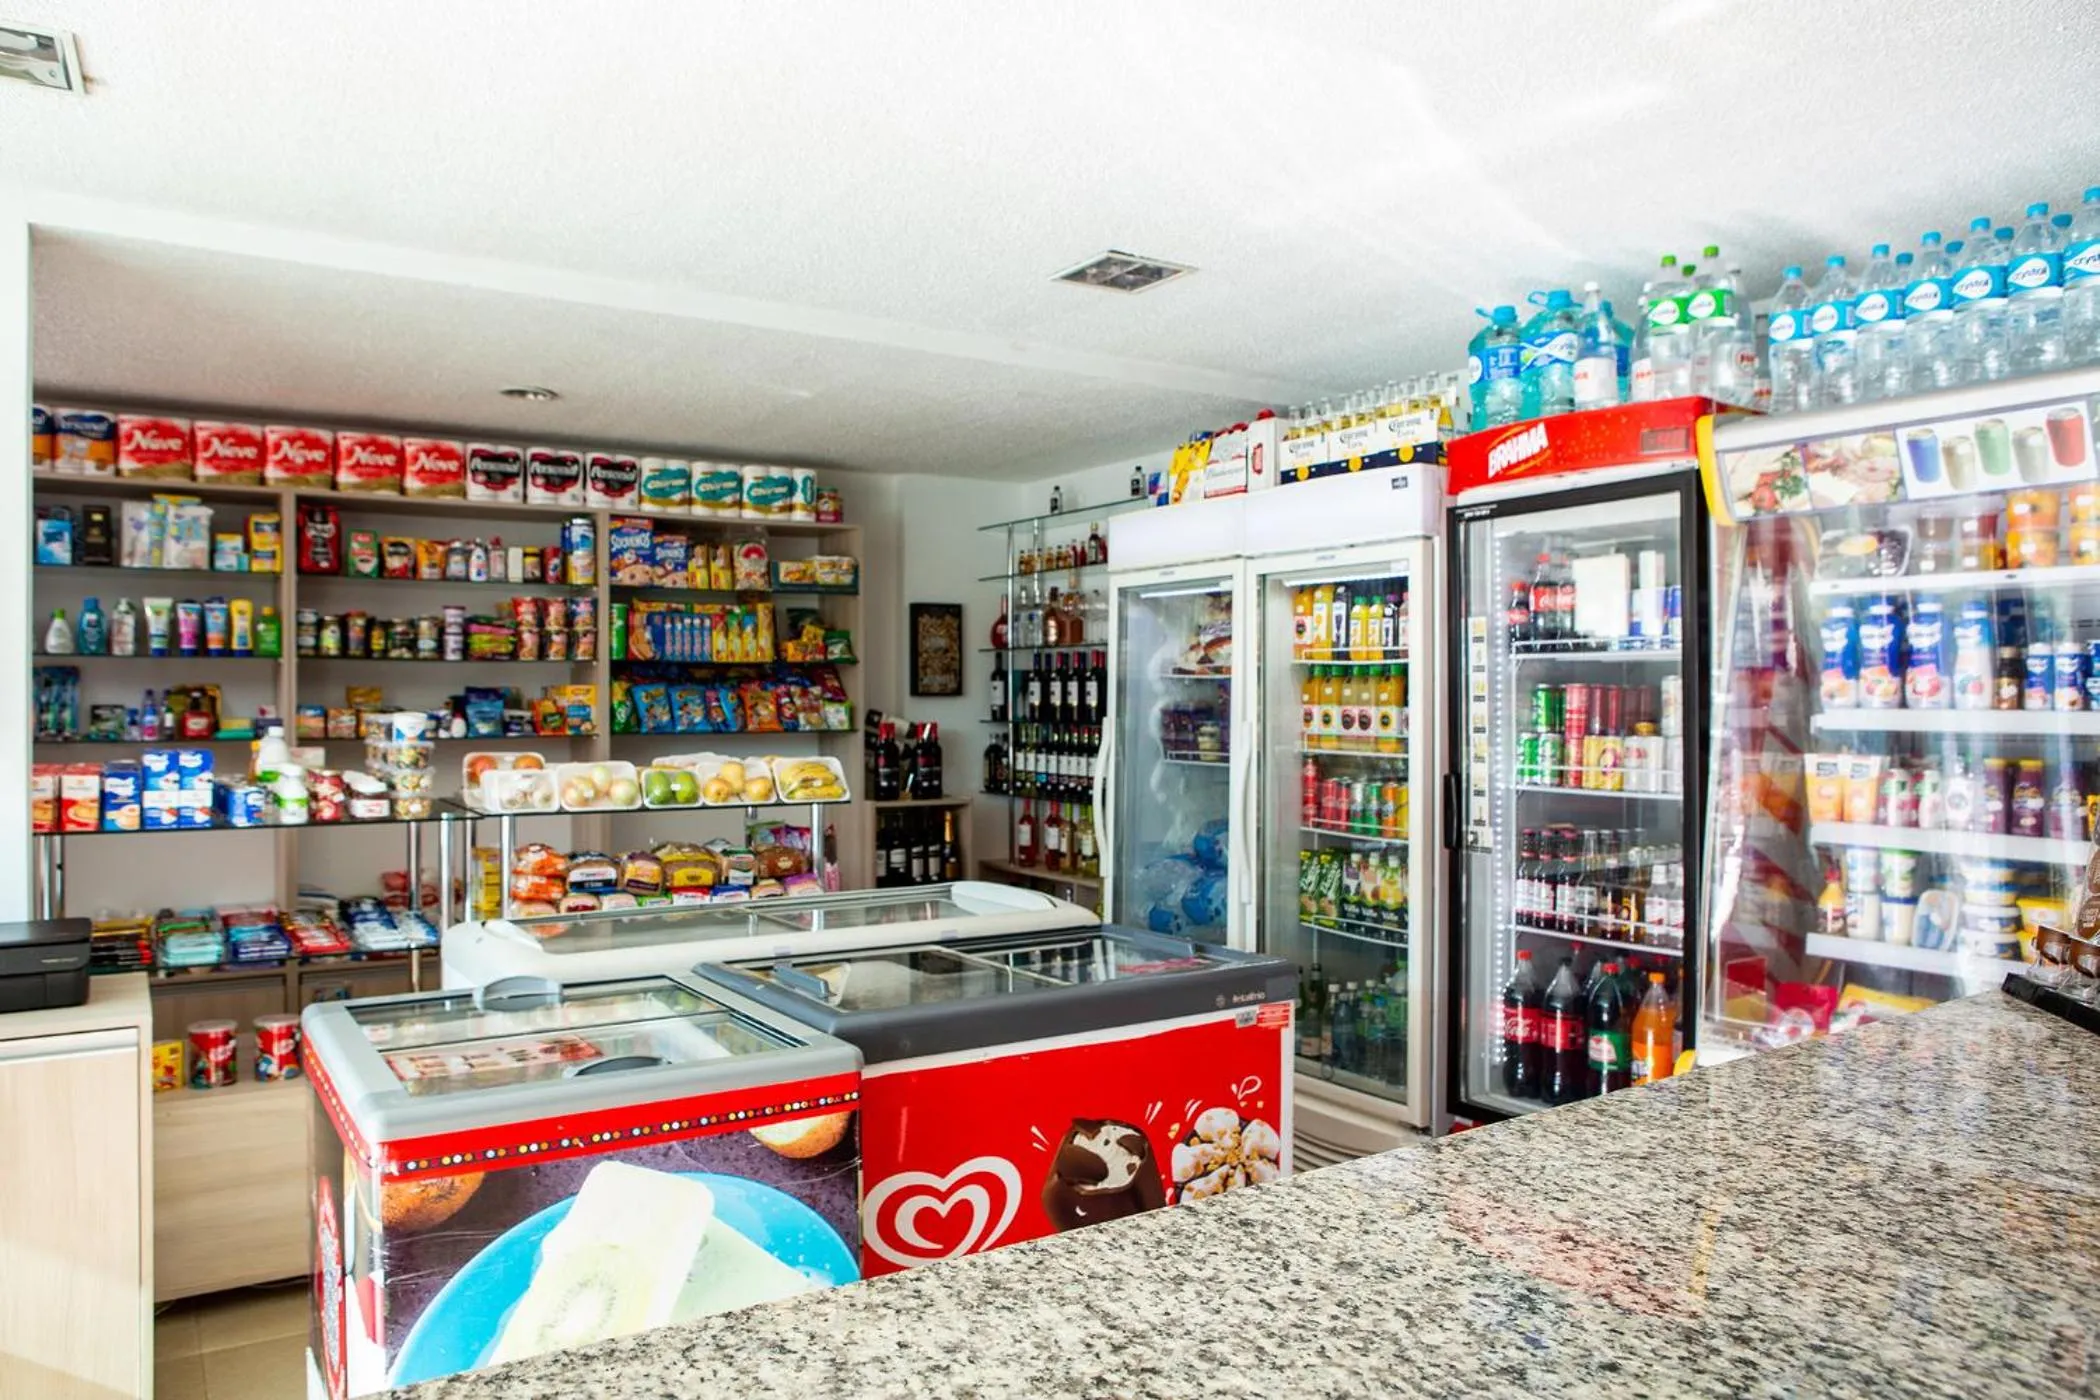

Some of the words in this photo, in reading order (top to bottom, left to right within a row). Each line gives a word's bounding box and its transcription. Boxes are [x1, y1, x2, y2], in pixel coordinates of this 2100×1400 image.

[129, 429, 183, 451] Neve
[203, 437, 258, 459] Neve
[273, 439, 327, 463] Neve
[1487, 422, 1549, 479] BRAHMA
[345, 445, 398, 467] Neve
[413, 452, 459, 472] Neve
